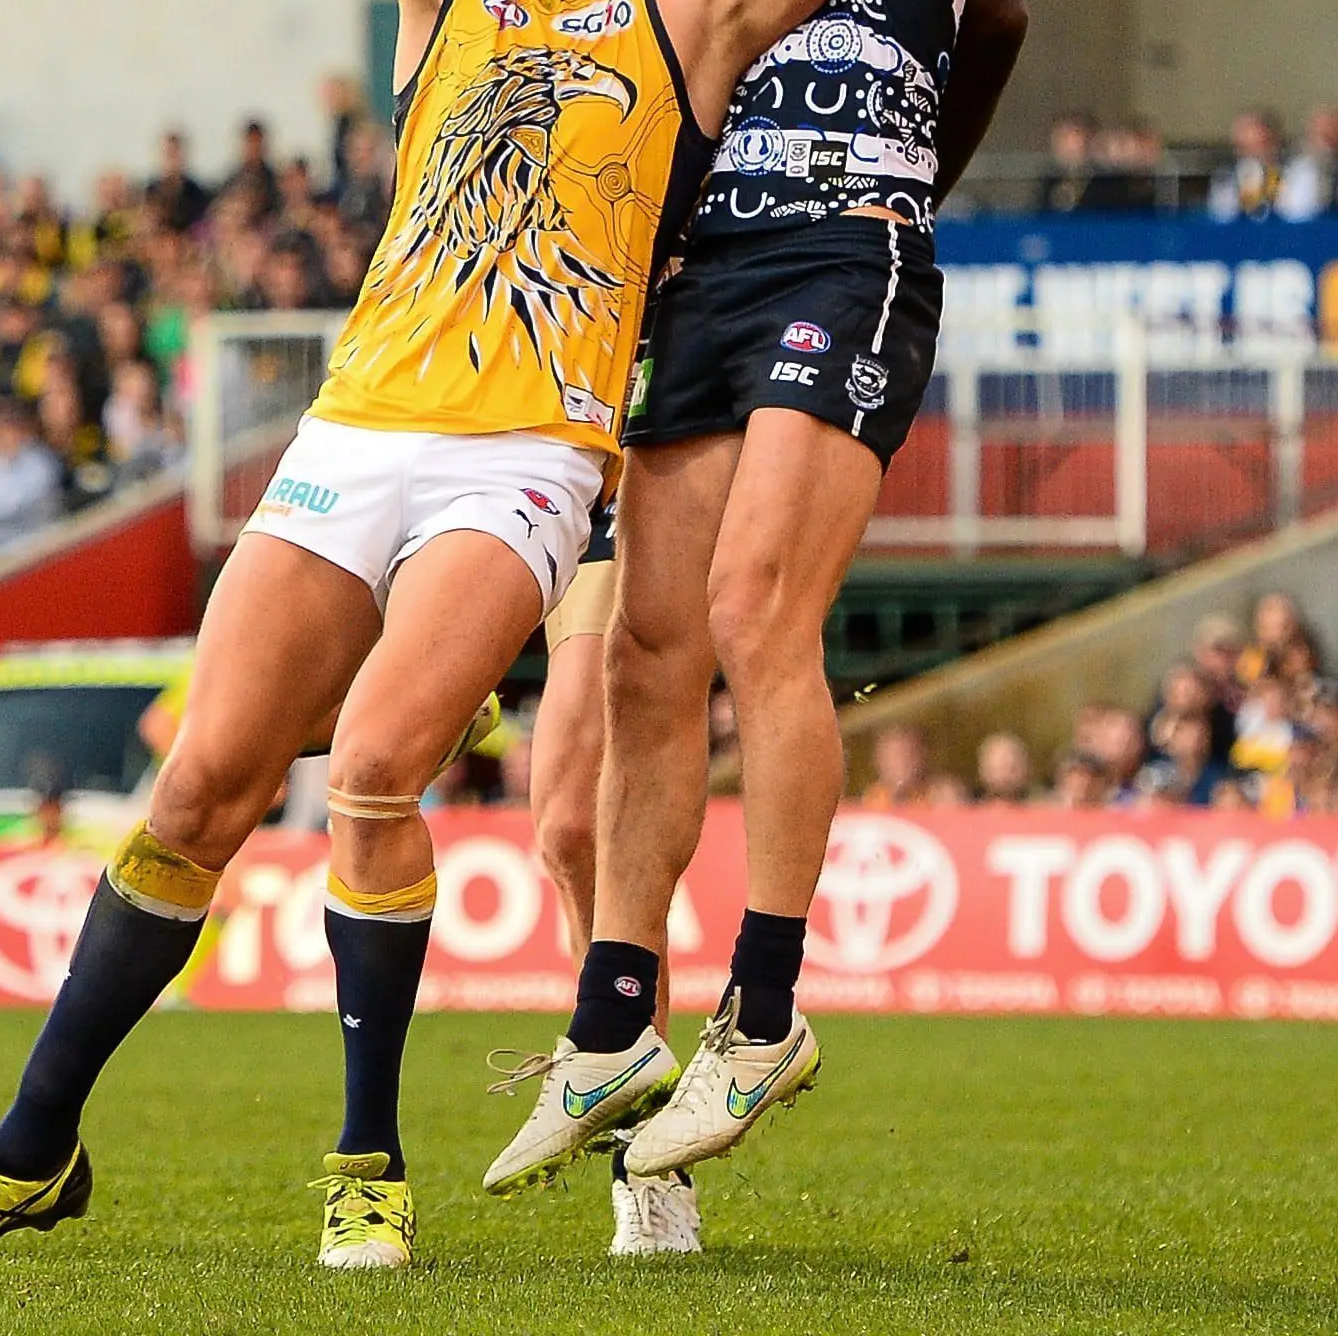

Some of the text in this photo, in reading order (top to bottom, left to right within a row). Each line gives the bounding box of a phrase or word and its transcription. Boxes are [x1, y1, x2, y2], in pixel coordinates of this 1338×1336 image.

[810, 150, 845, 166] ISC
[783, 326, 826, 350] AFL
[769, 361, 820, 386] ISC
